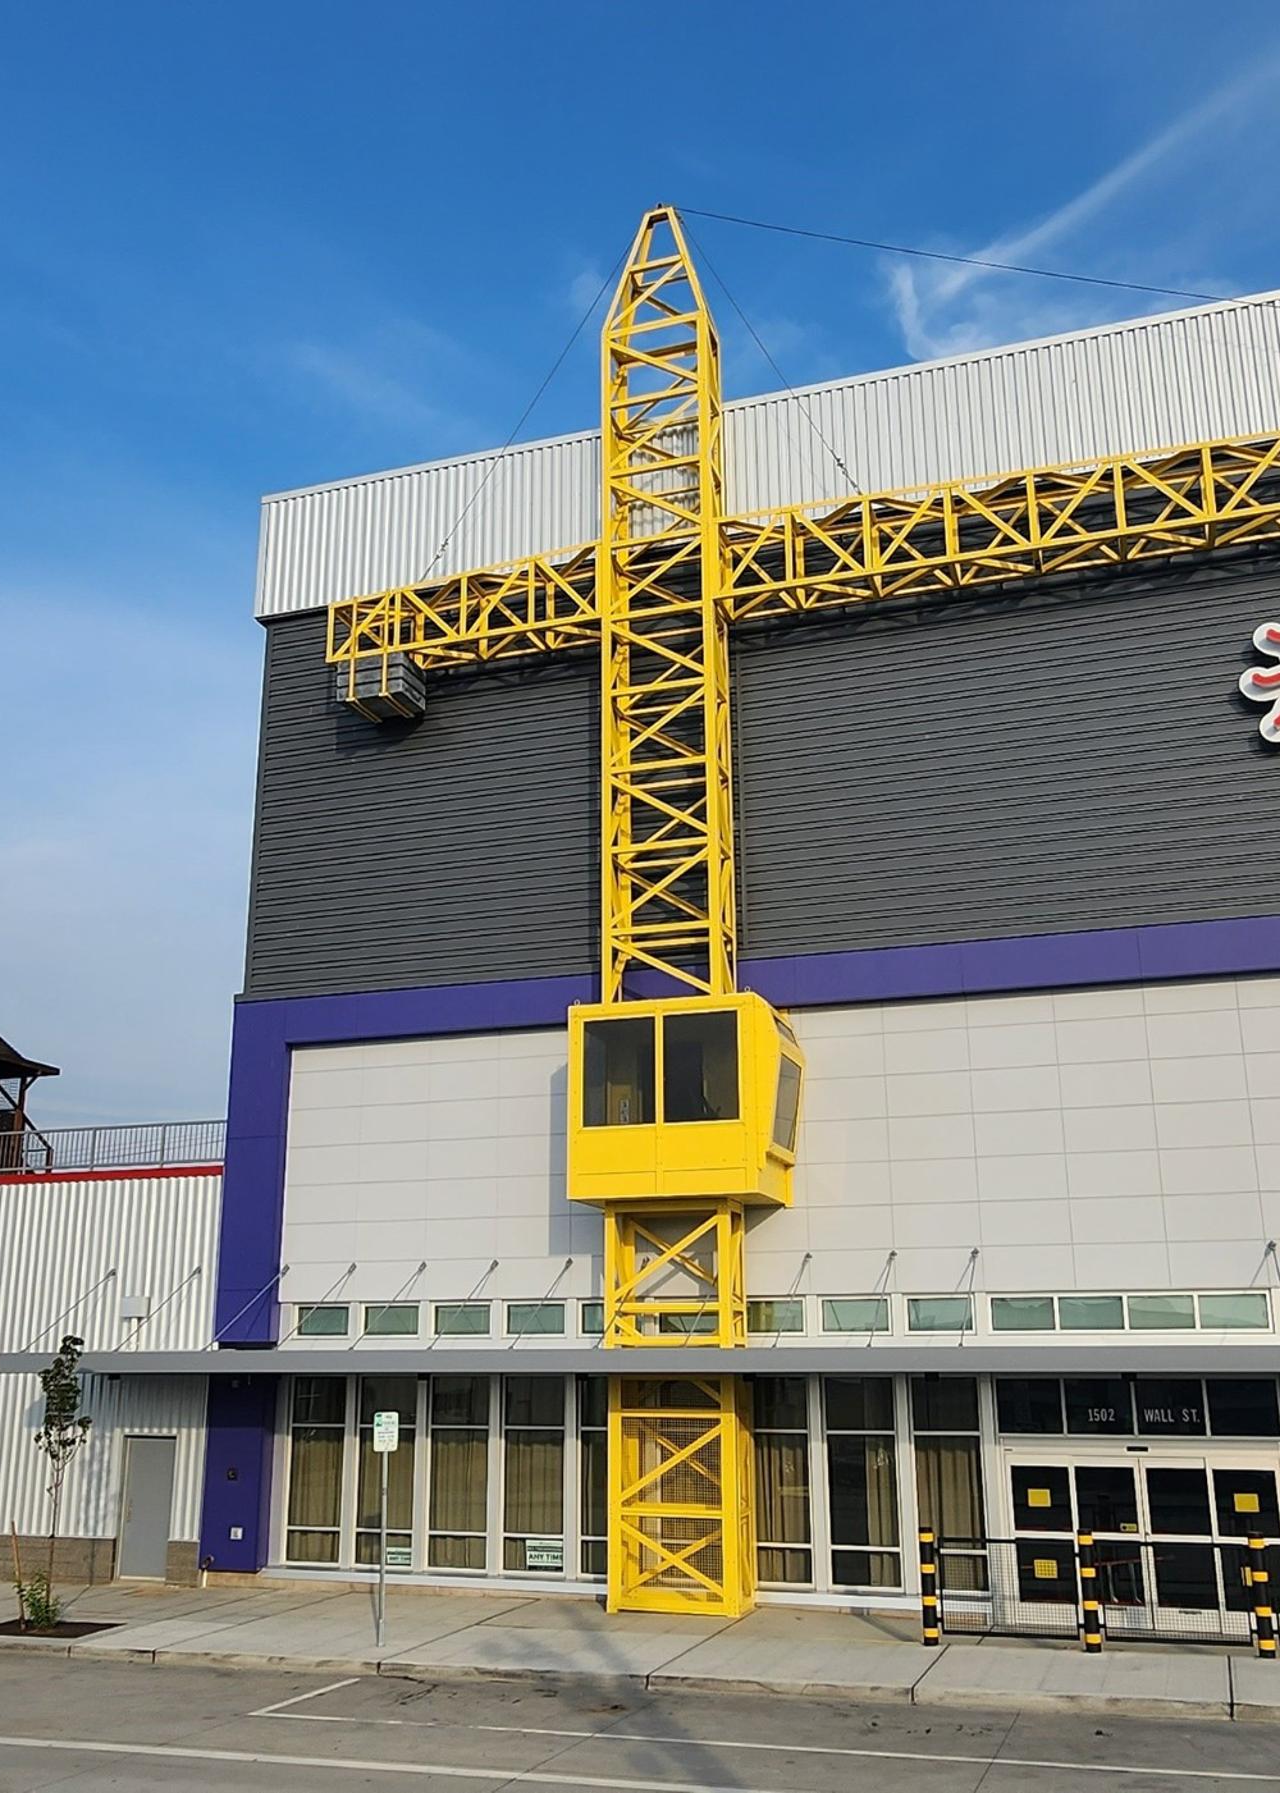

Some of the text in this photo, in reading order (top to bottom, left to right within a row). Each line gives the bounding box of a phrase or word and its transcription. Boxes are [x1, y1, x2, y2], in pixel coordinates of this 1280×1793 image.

[1087, 1408, 1201, 1423] 1502 WALL ST.
